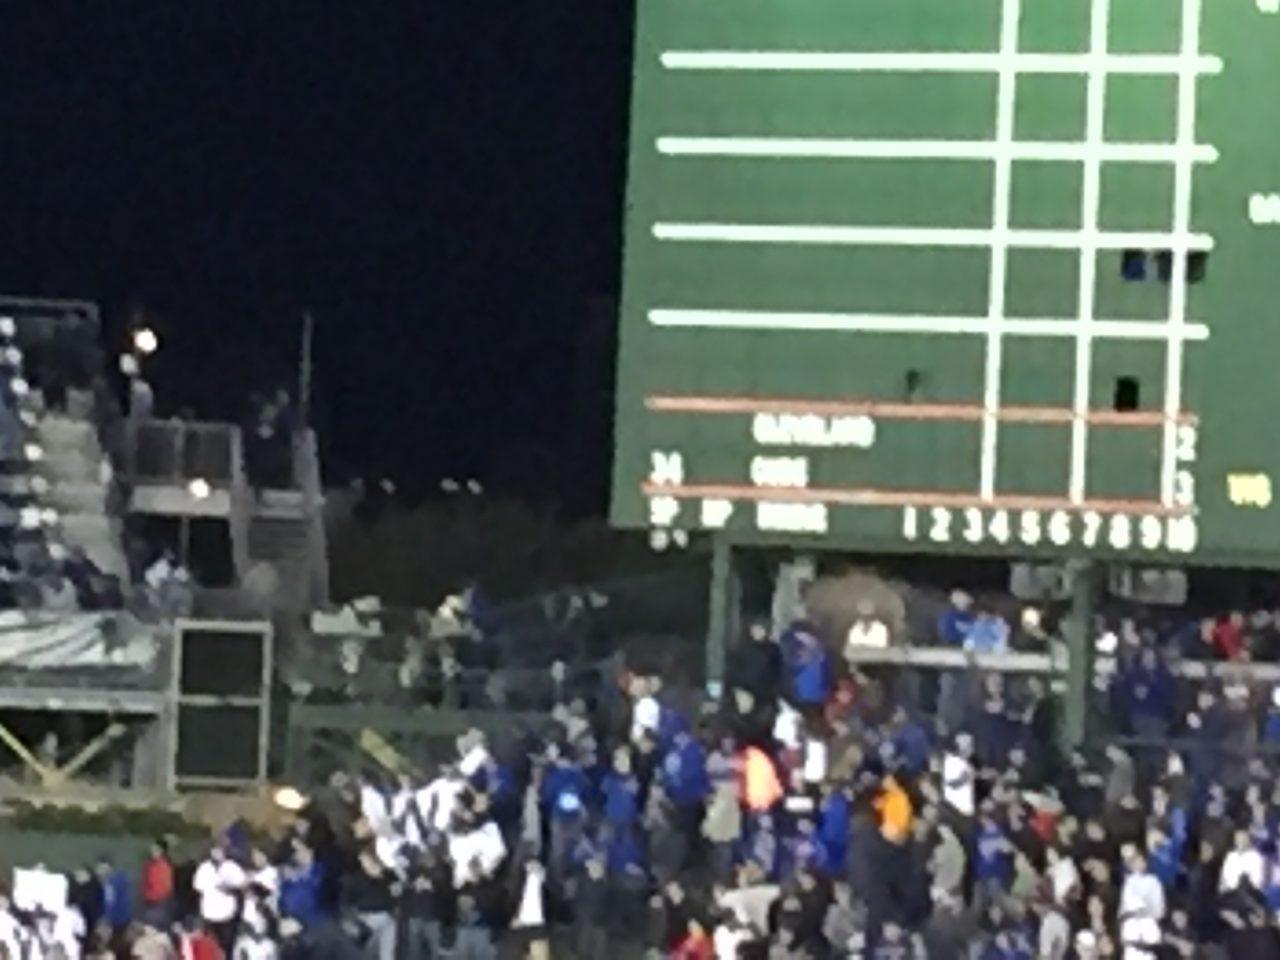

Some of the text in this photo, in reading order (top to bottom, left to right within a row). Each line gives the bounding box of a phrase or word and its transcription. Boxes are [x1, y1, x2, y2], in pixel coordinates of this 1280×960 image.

[903, 504, 917, 540] 1
[930, 506, 951, 541] 2
[964, 507, 983, 542] 3
[989, 509, 1010, 543] 4
[1021, 510, 1041, 545] 5
[1049, 510, 1071, 545] 6
[1083, 511, 1101, 547] 7
[1110, 514, 1131, 549] 8
[1140, 515, 1162, 549] 9
[1166, 515, 1197, 552] 10
